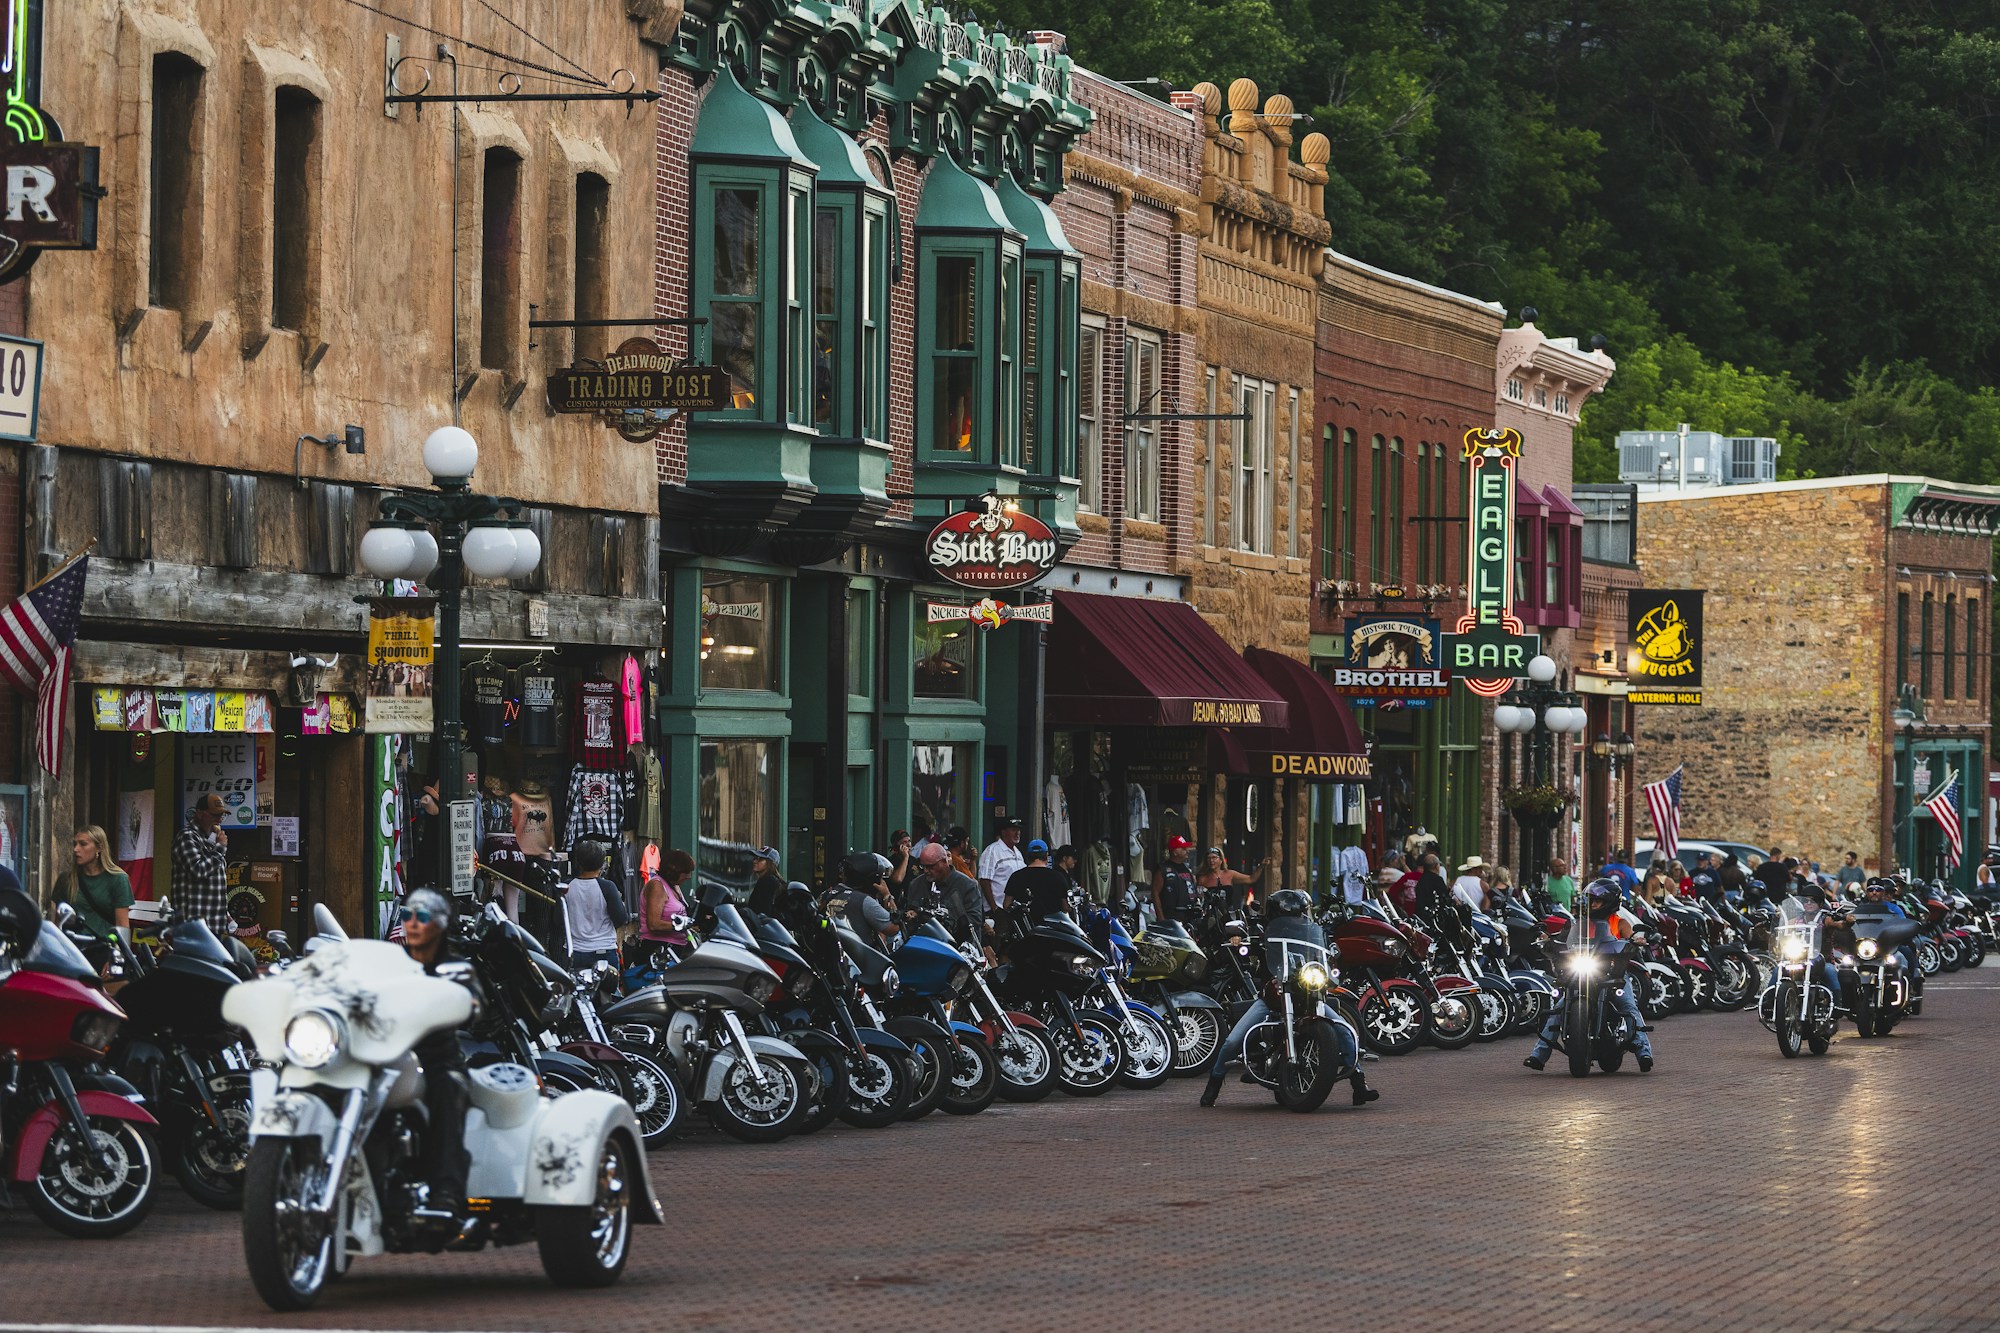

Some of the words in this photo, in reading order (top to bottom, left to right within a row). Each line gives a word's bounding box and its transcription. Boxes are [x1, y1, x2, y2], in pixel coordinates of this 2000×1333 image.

[4, 165, 59, 222] R
[605, 354, 674, 376] DEADWOOD
[568, 375, 652, 398] TRADING
[662, 374, 712, 397] POST
[566, 400, 600, 408] CUSTOM
[640, 399, 663, 407] GIFTS
[671, 399, 714, 407] SOUVENIRS
[929, 530, 996, 567] Sick
[997, 532, 1056, 568] Boy
[1479, 474, 1504, 625] EAGLE
[956, 572, 1028, 580] MOTORCYCLES
[931, 605, 968, 620] SICKIES
[1013, 605, 1050, 620] GARAGE
[384, 632, 419, 640] THRILL
[1361, 623, 1396, 637] HISTORIC
[1399, 623, 1423, 636] TOURS
[1636, 629, 1655, 646] THE
[374, 646, 429, 658] SHOOTOUT!
[1455, 643, 1524, 669] BAR
[1637, 658, 1695, 677] NUGGET
[475, 677, 503, 688] WELCOME
[525, 677, 555, 690] SHIT
[1334, 669, 1448, 687] BROTHEL
[525, 689, 555, 699] SHOW
[1336, 687, 1448, 695] DEADWOOD
[126, 690, 142, 710] Milk
[1628, 693, 1676, 703] WATERING
[1677, 693, 1702, 704] HOLE
[220, 703, 243, 717] Mexican
[225, 717, 239, 730] Food
[398, 714, 410, 722] Very
[191, 745, 246, 763] HERE
[214, 766, 223, 776] &
[1272, 754, 1370, 776] DEADWOOD
[456, 808, 469, 818] BIKE
[454, 820, 472, 830] PARKING
[457, 833, 469, 842] ONLY
